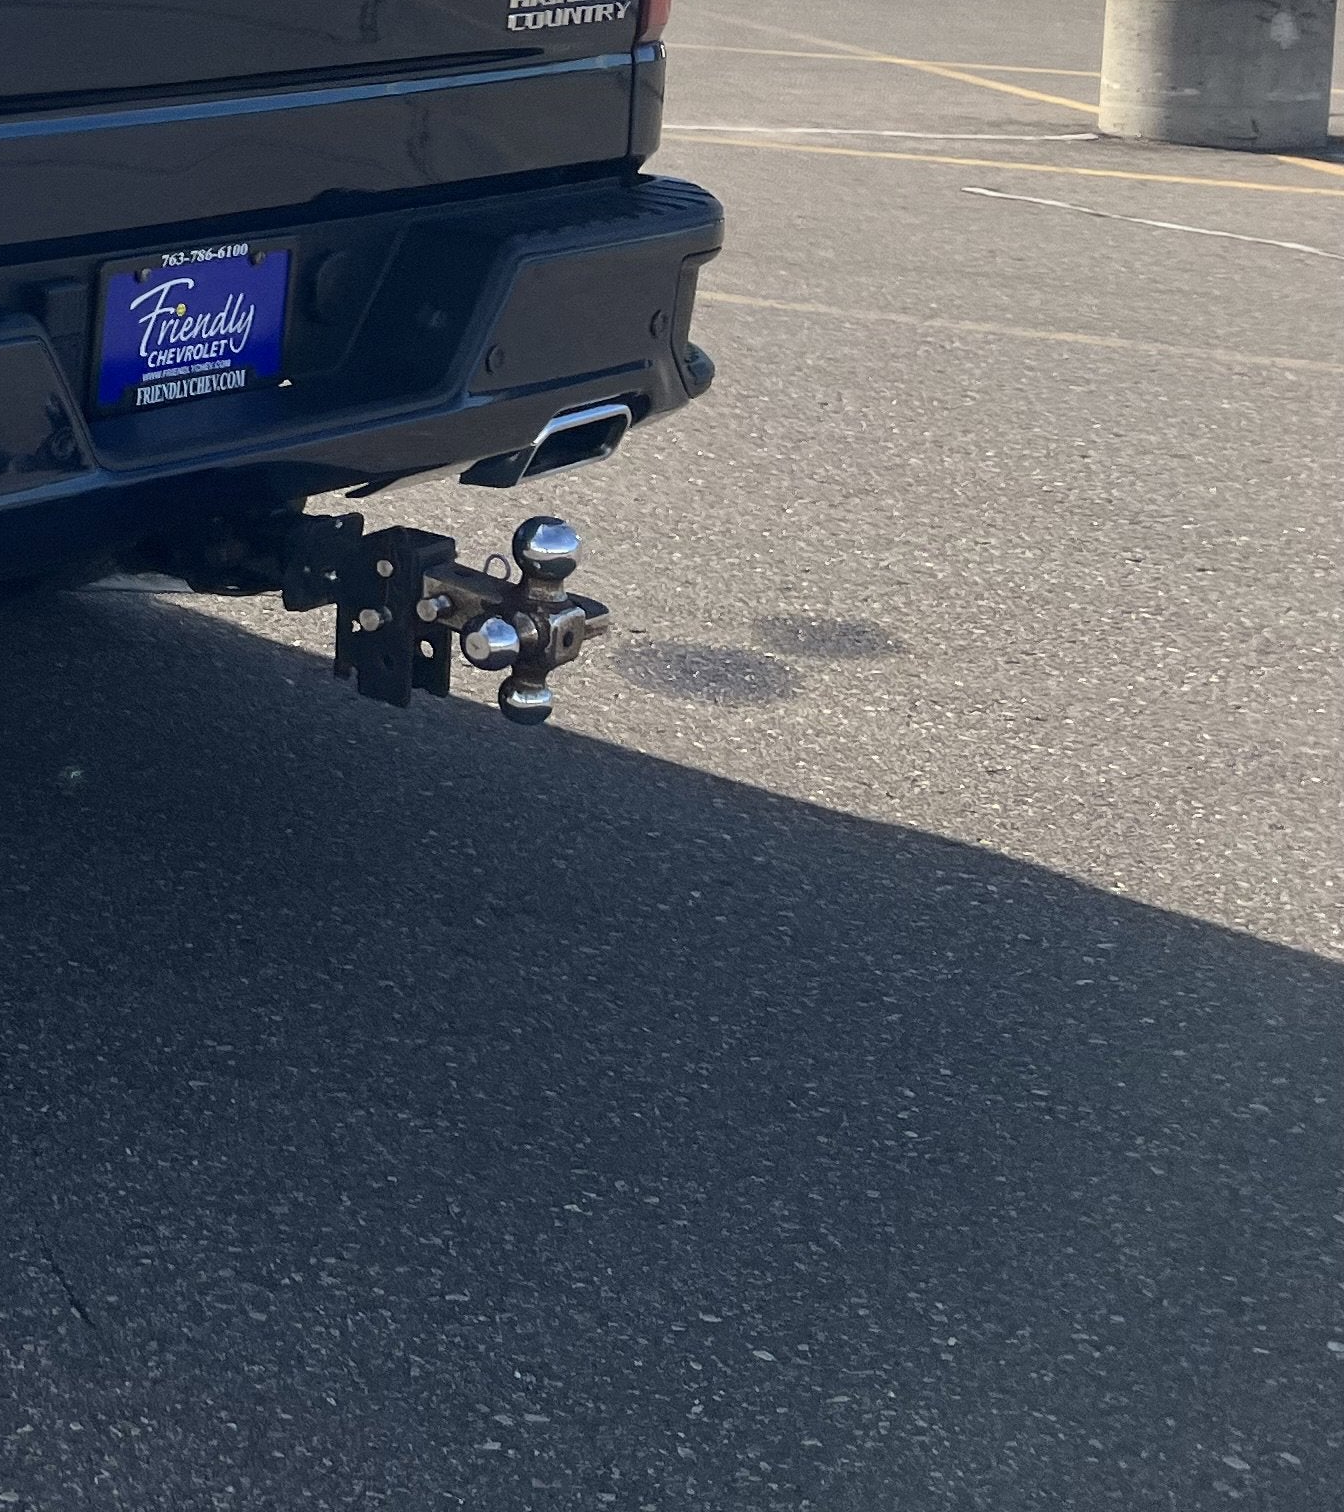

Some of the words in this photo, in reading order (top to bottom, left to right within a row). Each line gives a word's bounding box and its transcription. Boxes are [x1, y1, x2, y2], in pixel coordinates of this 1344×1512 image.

[508, 1, 631, 31] COUNTRY
[161, 243, 248, 267] 763-786-6100
[129, 277, 255, 357] Friendly
[147, 339, 228, 368] CHEVROLET
[136, 370, 246, 405] FRIENDLYCHEV.COM
